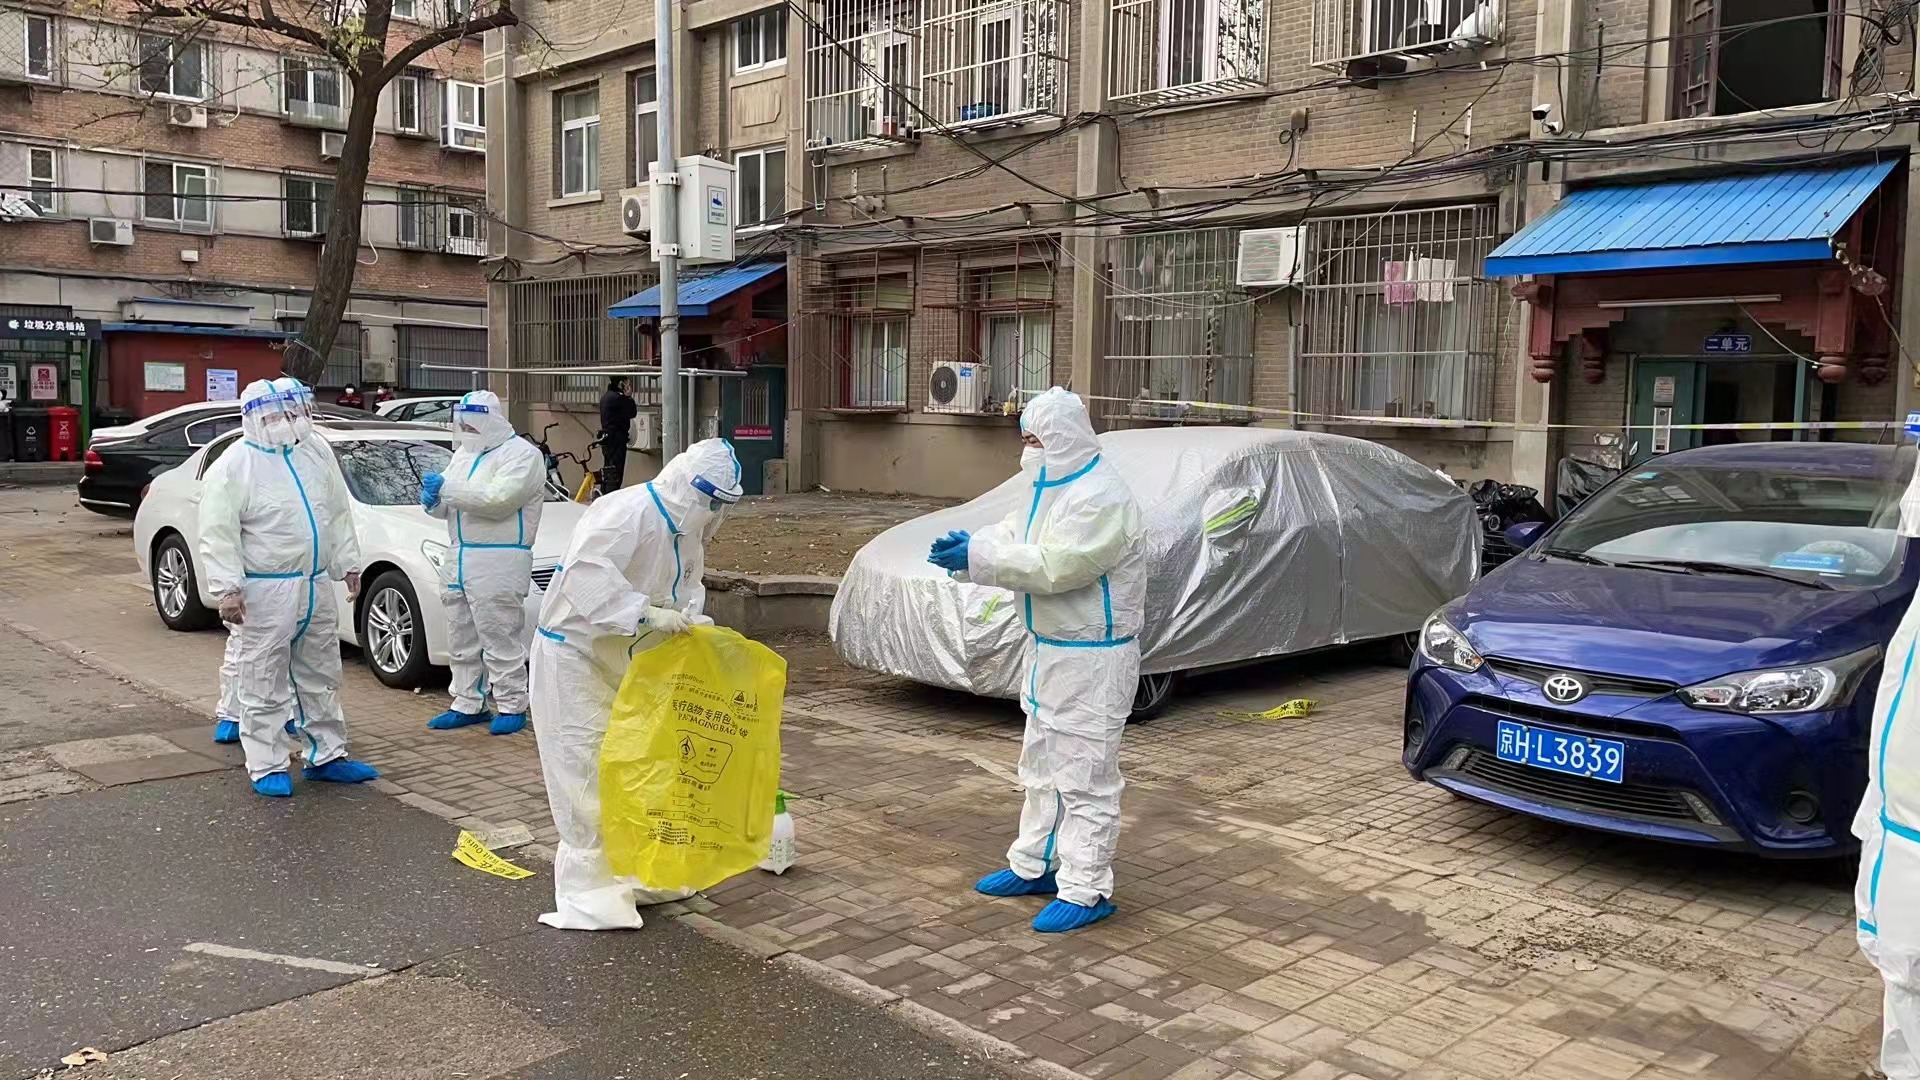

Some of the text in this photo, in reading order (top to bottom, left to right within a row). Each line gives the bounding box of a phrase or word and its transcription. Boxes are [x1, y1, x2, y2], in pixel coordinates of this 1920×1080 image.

[24, 319, 86, 332] 垃圾分类桶站
[1706, 337, 1748, 351] 二单元
[720, 724, 737, 736] BAG
